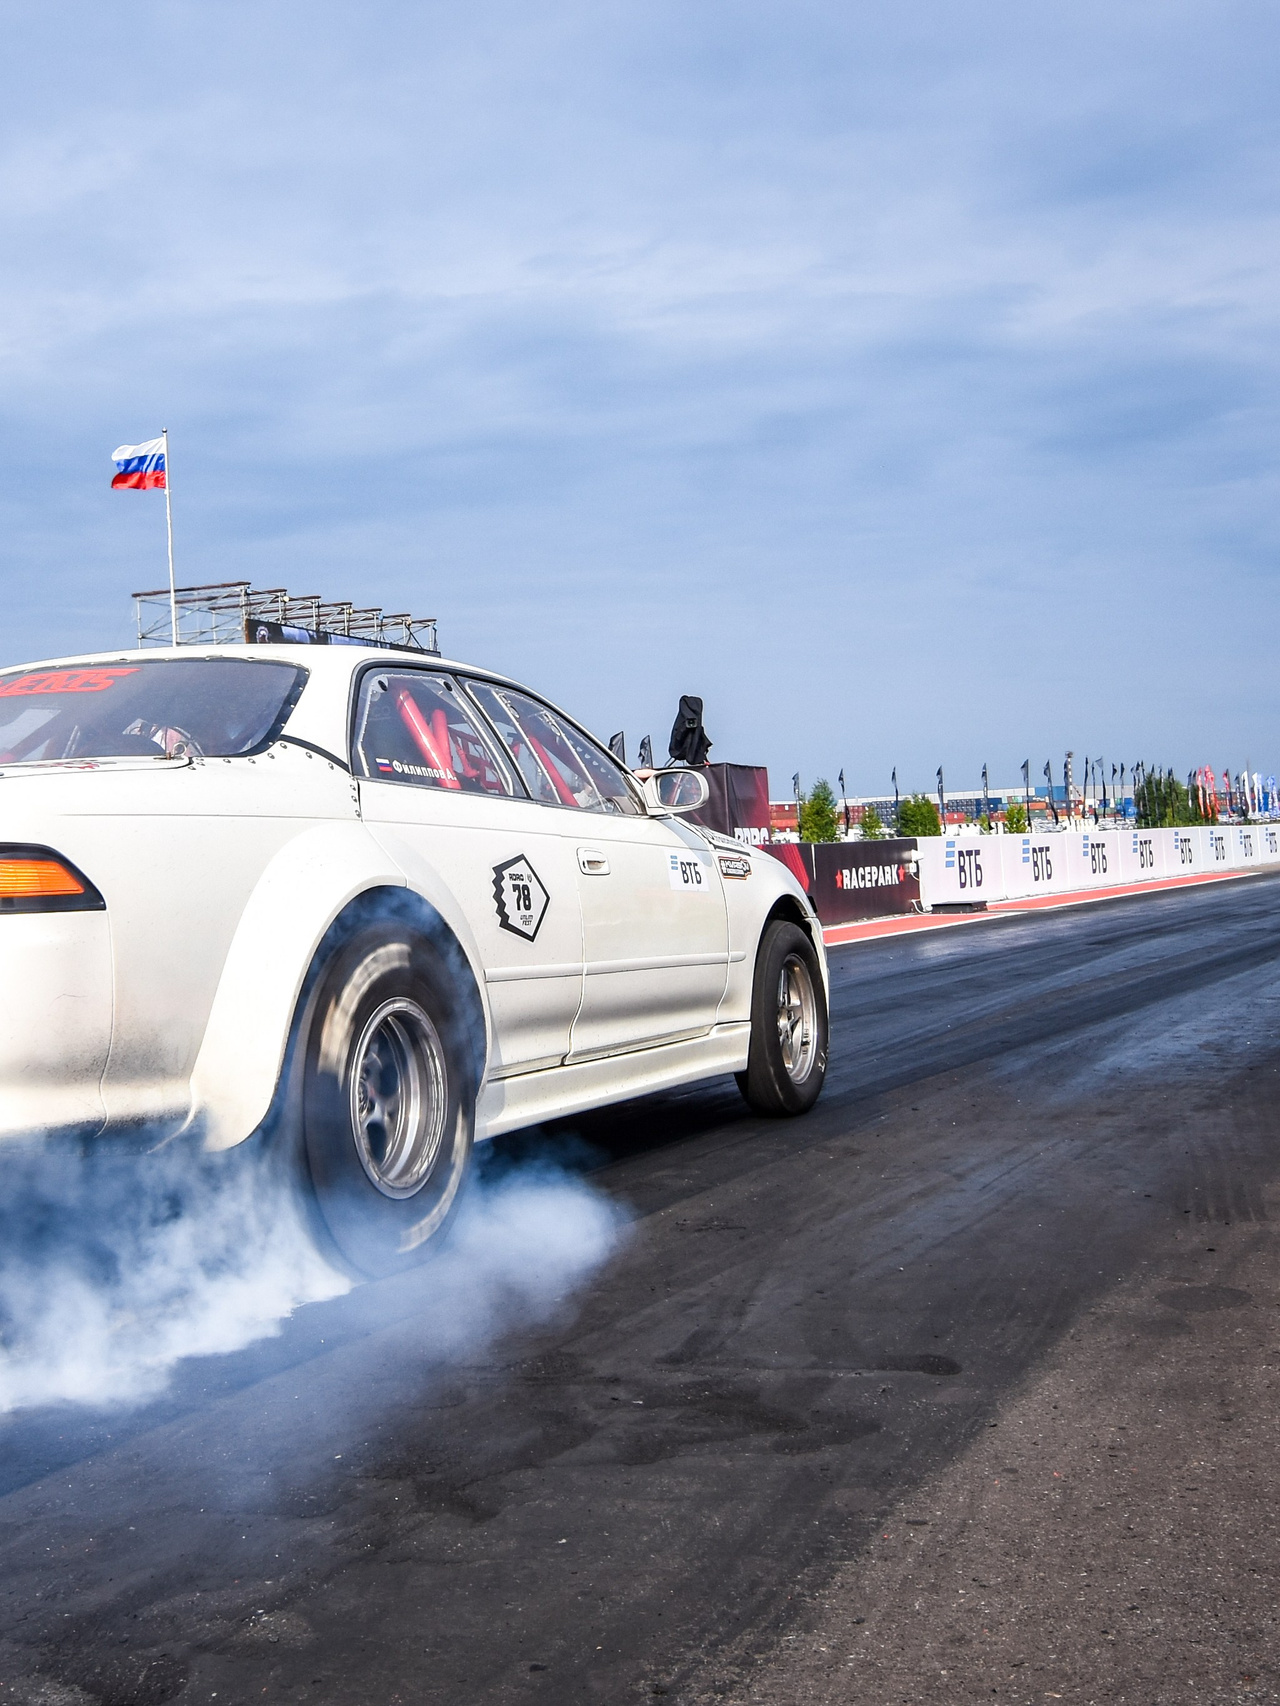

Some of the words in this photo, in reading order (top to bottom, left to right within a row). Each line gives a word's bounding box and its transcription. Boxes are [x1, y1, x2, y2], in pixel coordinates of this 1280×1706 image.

[392, 760, 446, 779] Филиппов
[1031, 846, 1053, 881] ВТБ
[1090, 843, 1108, 874] ВТБ
[1139, 840, 1154, 869] ВТБ
[1180, 838, 1193, 864] ВТБ
[680, 861, 702, 884] ВТБ
[842, 864, 900, 890] RACEPARK
[957, 849, 983, 889] ВТБ
[512, 883, 532, 911] 78
